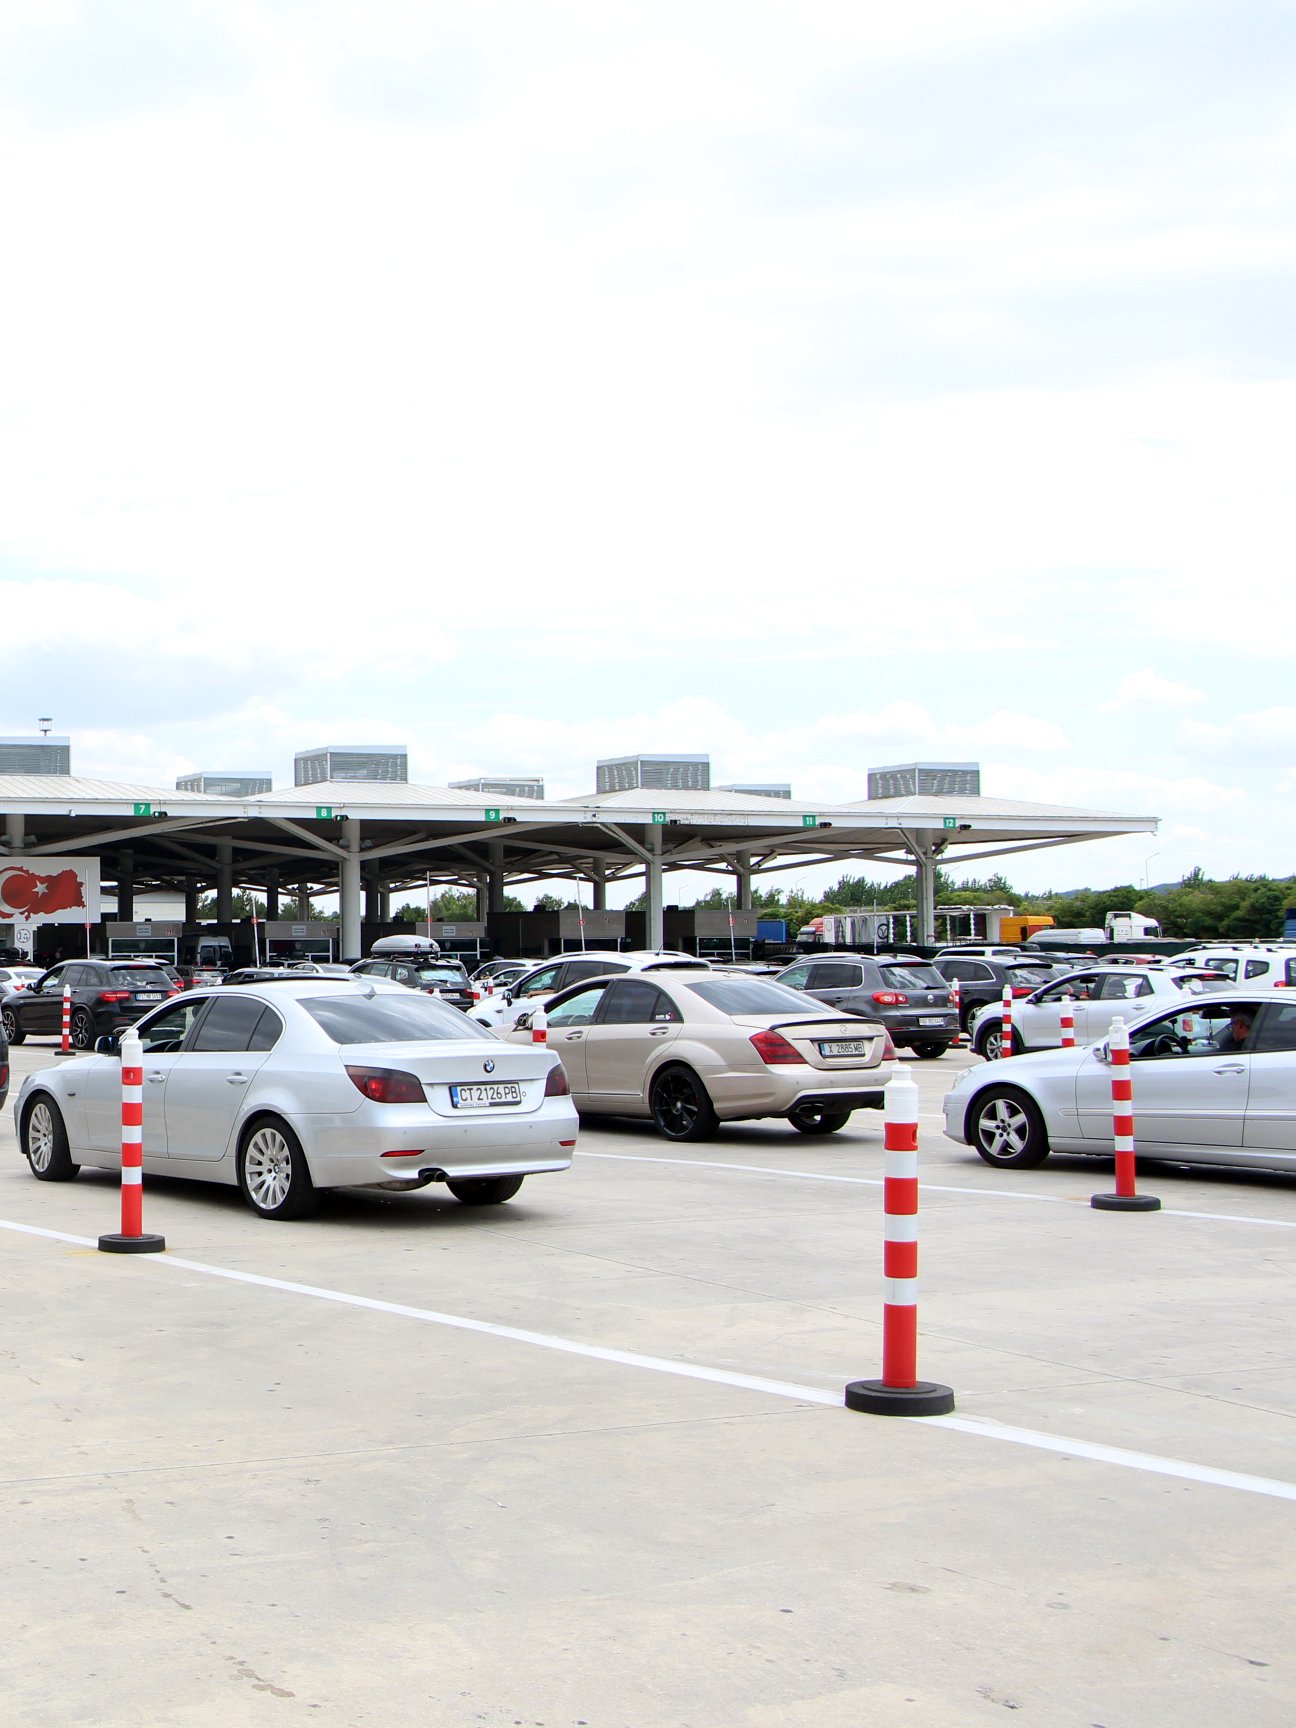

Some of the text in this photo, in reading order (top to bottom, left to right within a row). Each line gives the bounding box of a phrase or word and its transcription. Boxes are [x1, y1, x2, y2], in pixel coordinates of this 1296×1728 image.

[139, 804, 146, 814] 7
[321, 808, 327, 817] 8
[489, 811, 496, 819] 9
[654, 814, 664, 822] 10
[806, 817, 813, 825] 11
[945, 819, 954, 827] 12
[459, 1086, 518, 1101] CT 2126 PB
